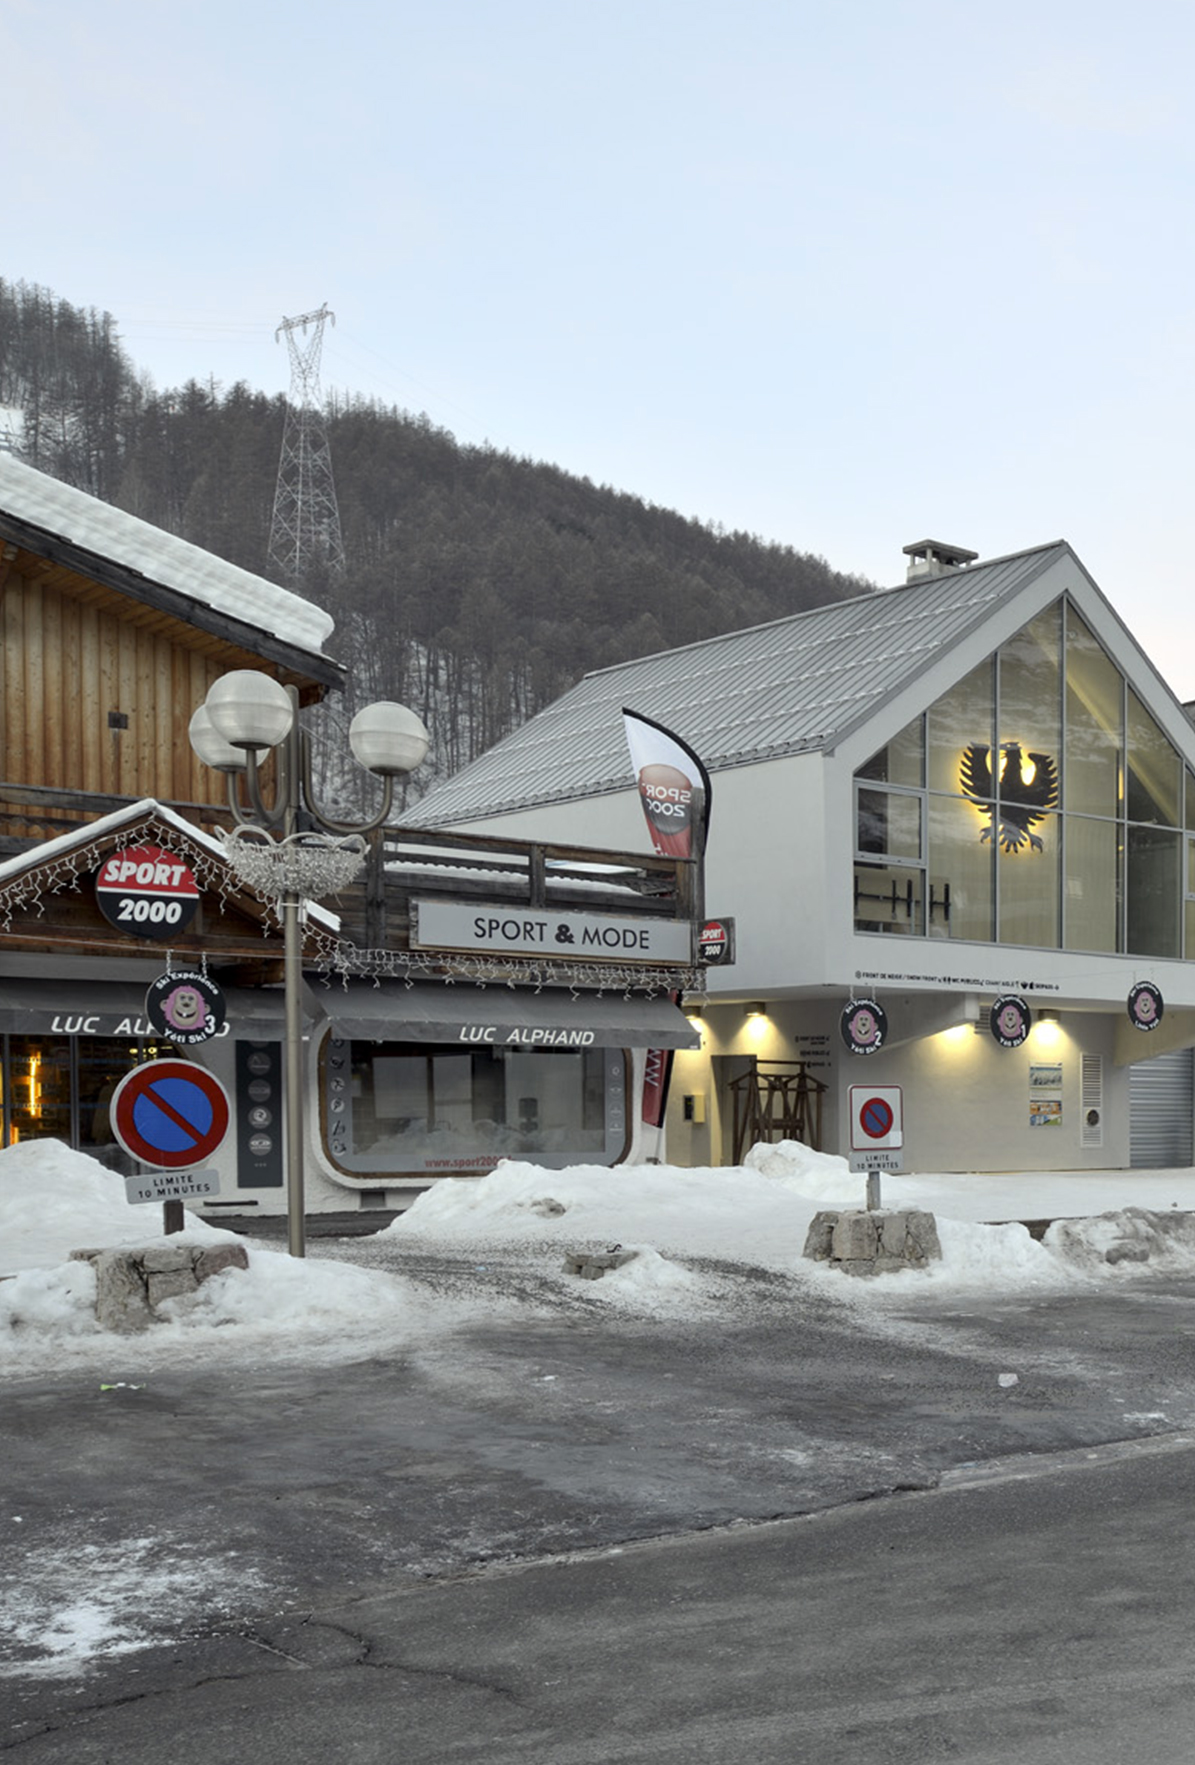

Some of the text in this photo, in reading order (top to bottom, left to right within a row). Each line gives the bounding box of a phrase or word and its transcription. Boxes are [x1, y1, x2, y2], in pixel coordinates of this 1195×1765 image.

[104, 859, 186, 887] SPORT
[117, 899, 182, 924] 2000
[474, 917, 650, 950] SPORT & MODE
[701, 928, 725, 941] SPORT
[704, 945, 721, 956] 2000
[156, 974, 170, 990] Ski
[51, 1016, 100, 1033] LUC
[204, 1015, 216, 1034] 3
[188, 1032, 207, 1044] Ski
[459, 1026, 595, 1046] LUC ALPHAND
[874, 1031, 882, 1046] 2
[865, 1154, 889, 1162] LIMITE
[868, 1161, 899, 1169] MINUTES
[153, 1174, 194, 1187] LIMITE
[138, 1183, 211, 1199] 10 MINUTES
